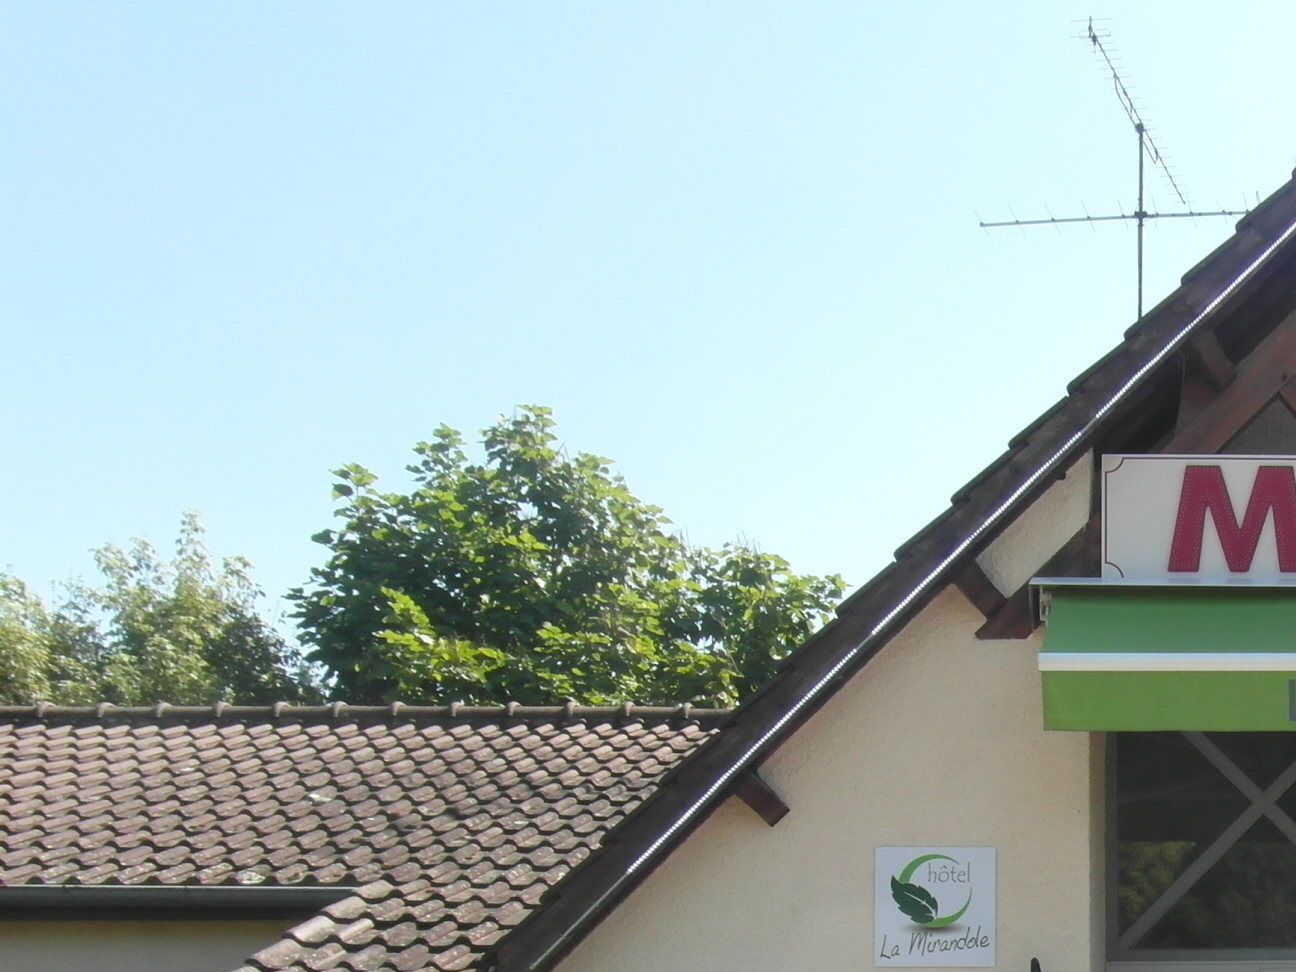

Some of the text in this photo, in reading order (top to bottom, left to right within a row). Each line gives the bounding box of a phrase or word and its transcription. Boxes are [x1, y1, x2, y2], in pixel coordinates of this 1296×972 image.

[928, 862, 971, 883] hôtel
[880, 926, 990, 960] La Mirandole
